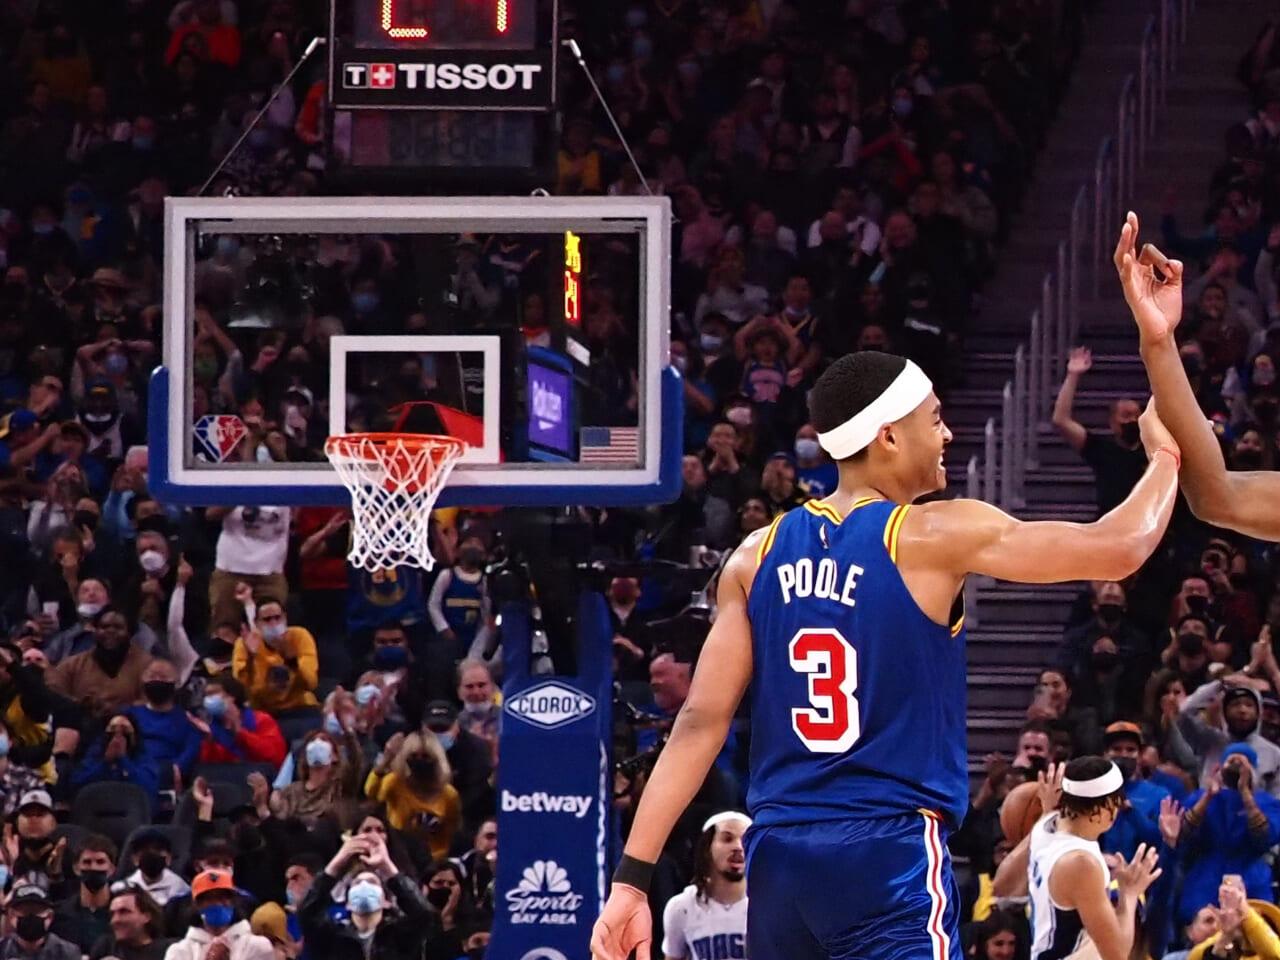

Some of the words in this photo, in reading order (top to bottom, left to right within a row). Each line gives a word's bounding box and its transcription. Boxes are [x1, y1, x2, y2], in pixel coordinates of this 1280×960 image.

[398, 63, 541, 90] TISSOT
[777, 557, 865, 607] POOLE
[788, 627, 861, 754] 3
[518, 696, 582, 714] CLOROX
[501, 789, 593, 818] betway
[505, 888, 583, 913] Sports
[510, 913, 536, 924] BAY
[539, 913, 577, 924] AREA
